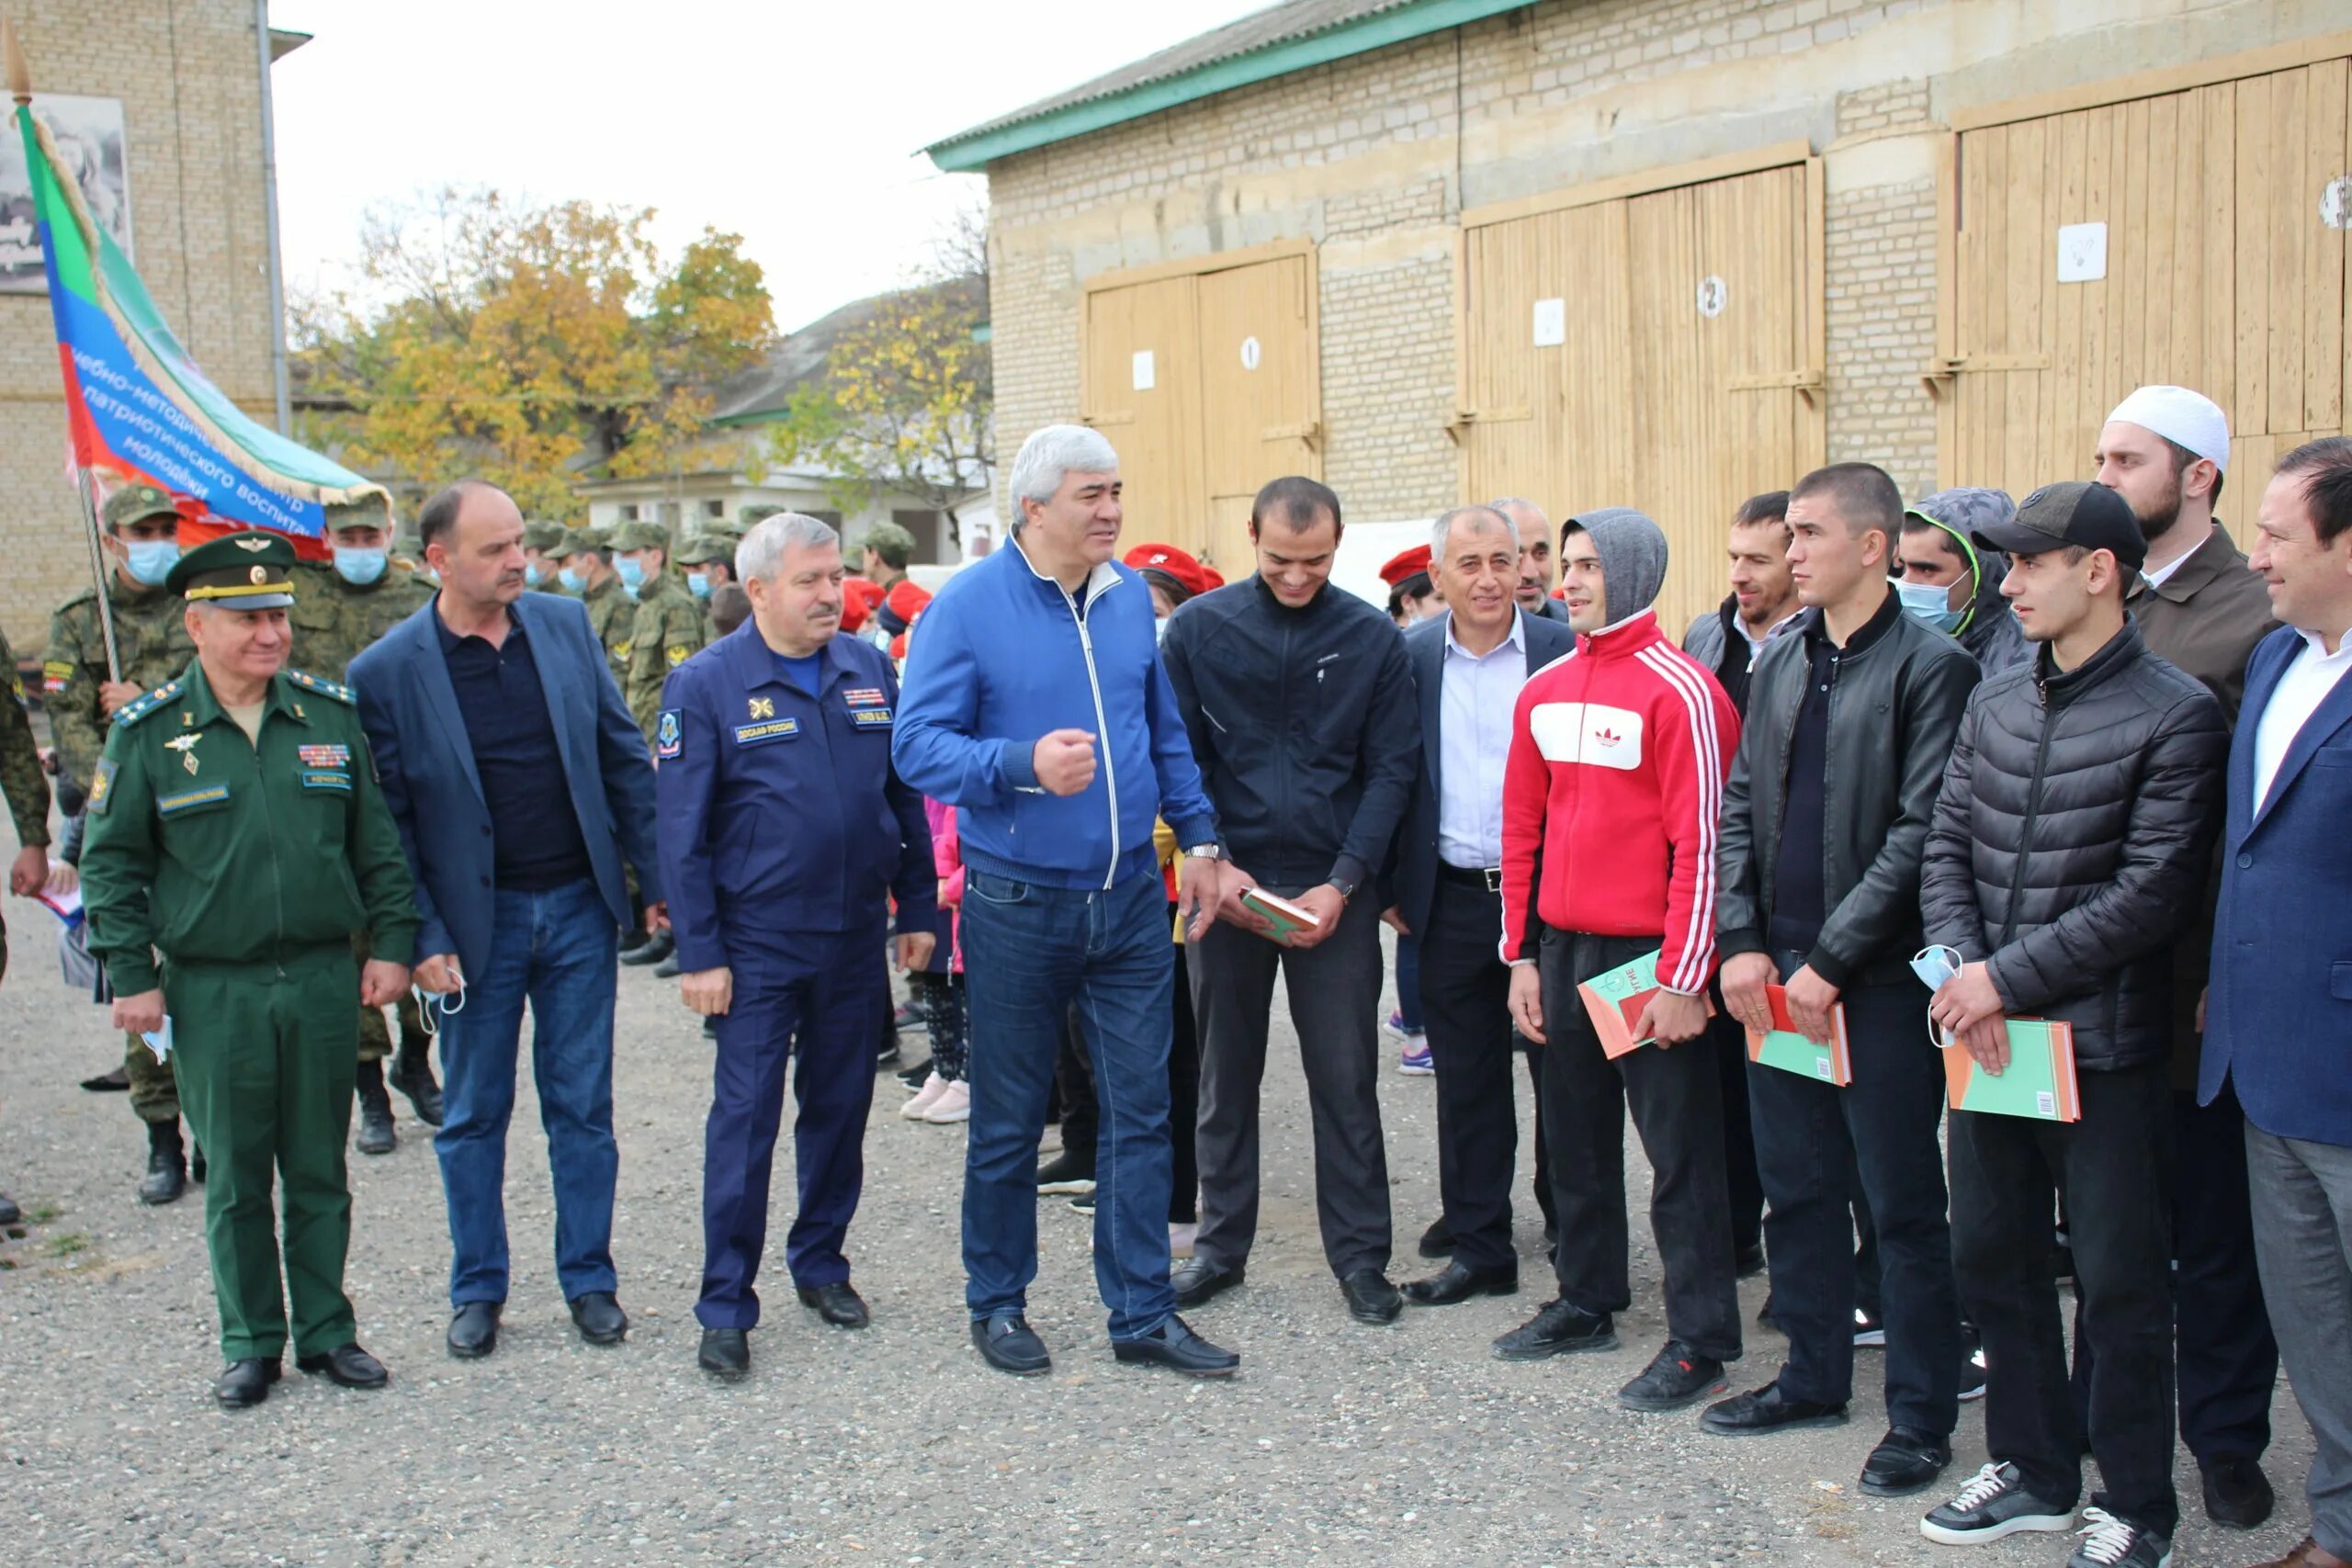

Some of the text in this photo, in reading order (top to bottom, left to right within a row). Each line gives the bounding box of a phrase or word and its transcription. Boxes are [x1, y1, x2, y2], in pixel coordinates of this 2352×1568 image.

[74, 348, 221, 456] чебно-методиче
[84, 386, 234, 489] патриотического
[123, 436, 209, 500] молодёжи
